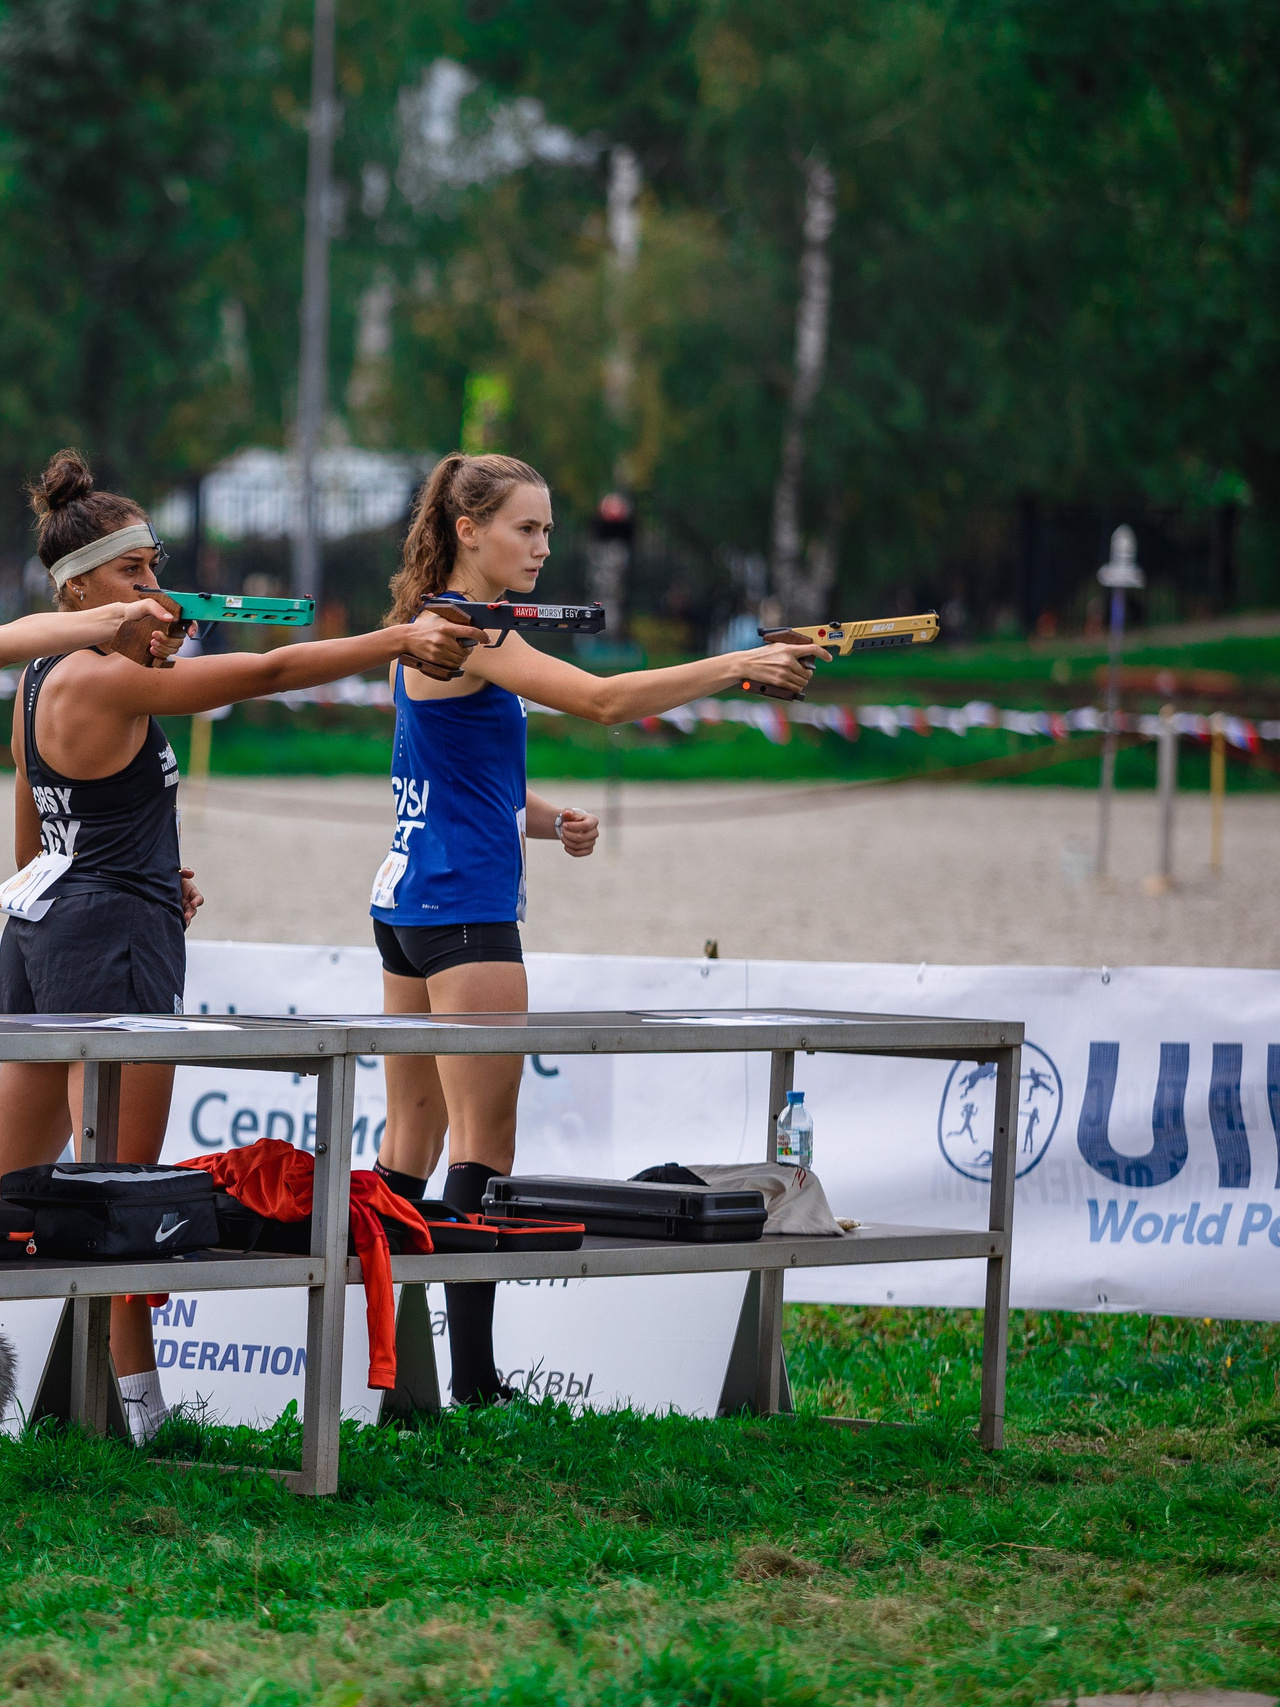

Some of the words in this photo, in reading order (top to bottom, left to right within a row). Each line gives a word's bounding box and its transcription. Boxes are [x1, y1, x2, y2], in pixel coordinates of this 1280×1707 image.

[515, 607, 537, 617] HAYDY
[538, 607, 562, 618] MORSY
[565, 609, 579, 619] EGY
[1087, 1198, 1233, 1245] World
